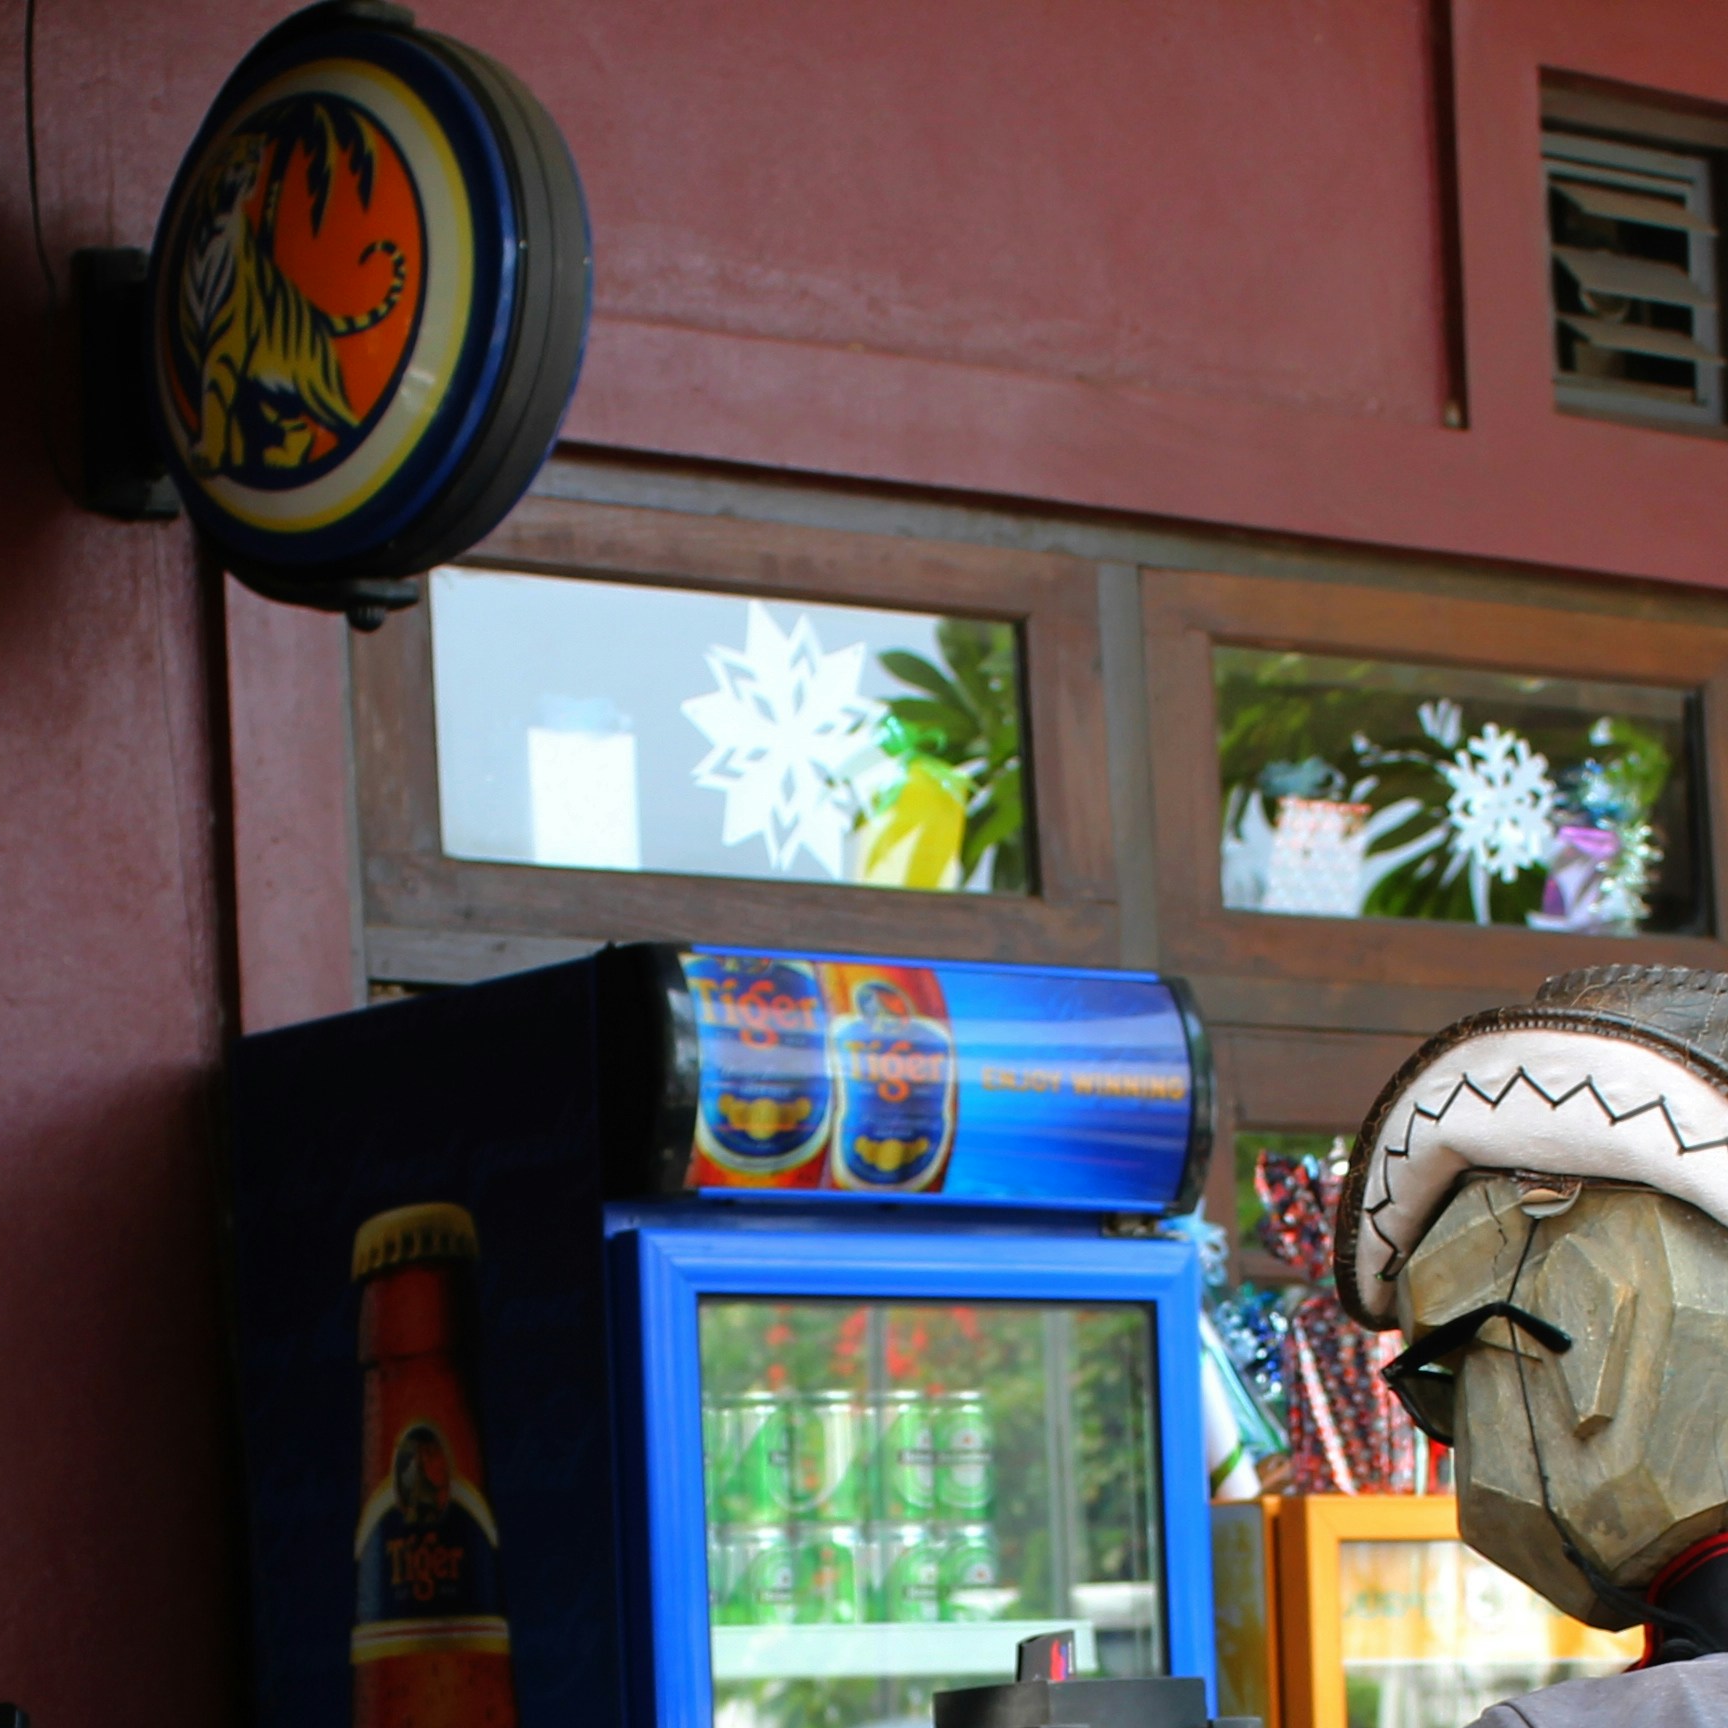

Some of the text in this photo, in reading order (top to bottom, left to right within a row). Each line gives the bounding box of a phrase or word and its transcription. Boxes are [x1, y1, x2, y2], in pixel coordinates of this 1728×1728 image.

[687, 976, 819, 1050] Tiger
[843, 1039, 946, 1103] Tiger
[981, 1066, 1186, 1101] ENJOY WINNING
[387, 1530, 464, 1601] Tiger
